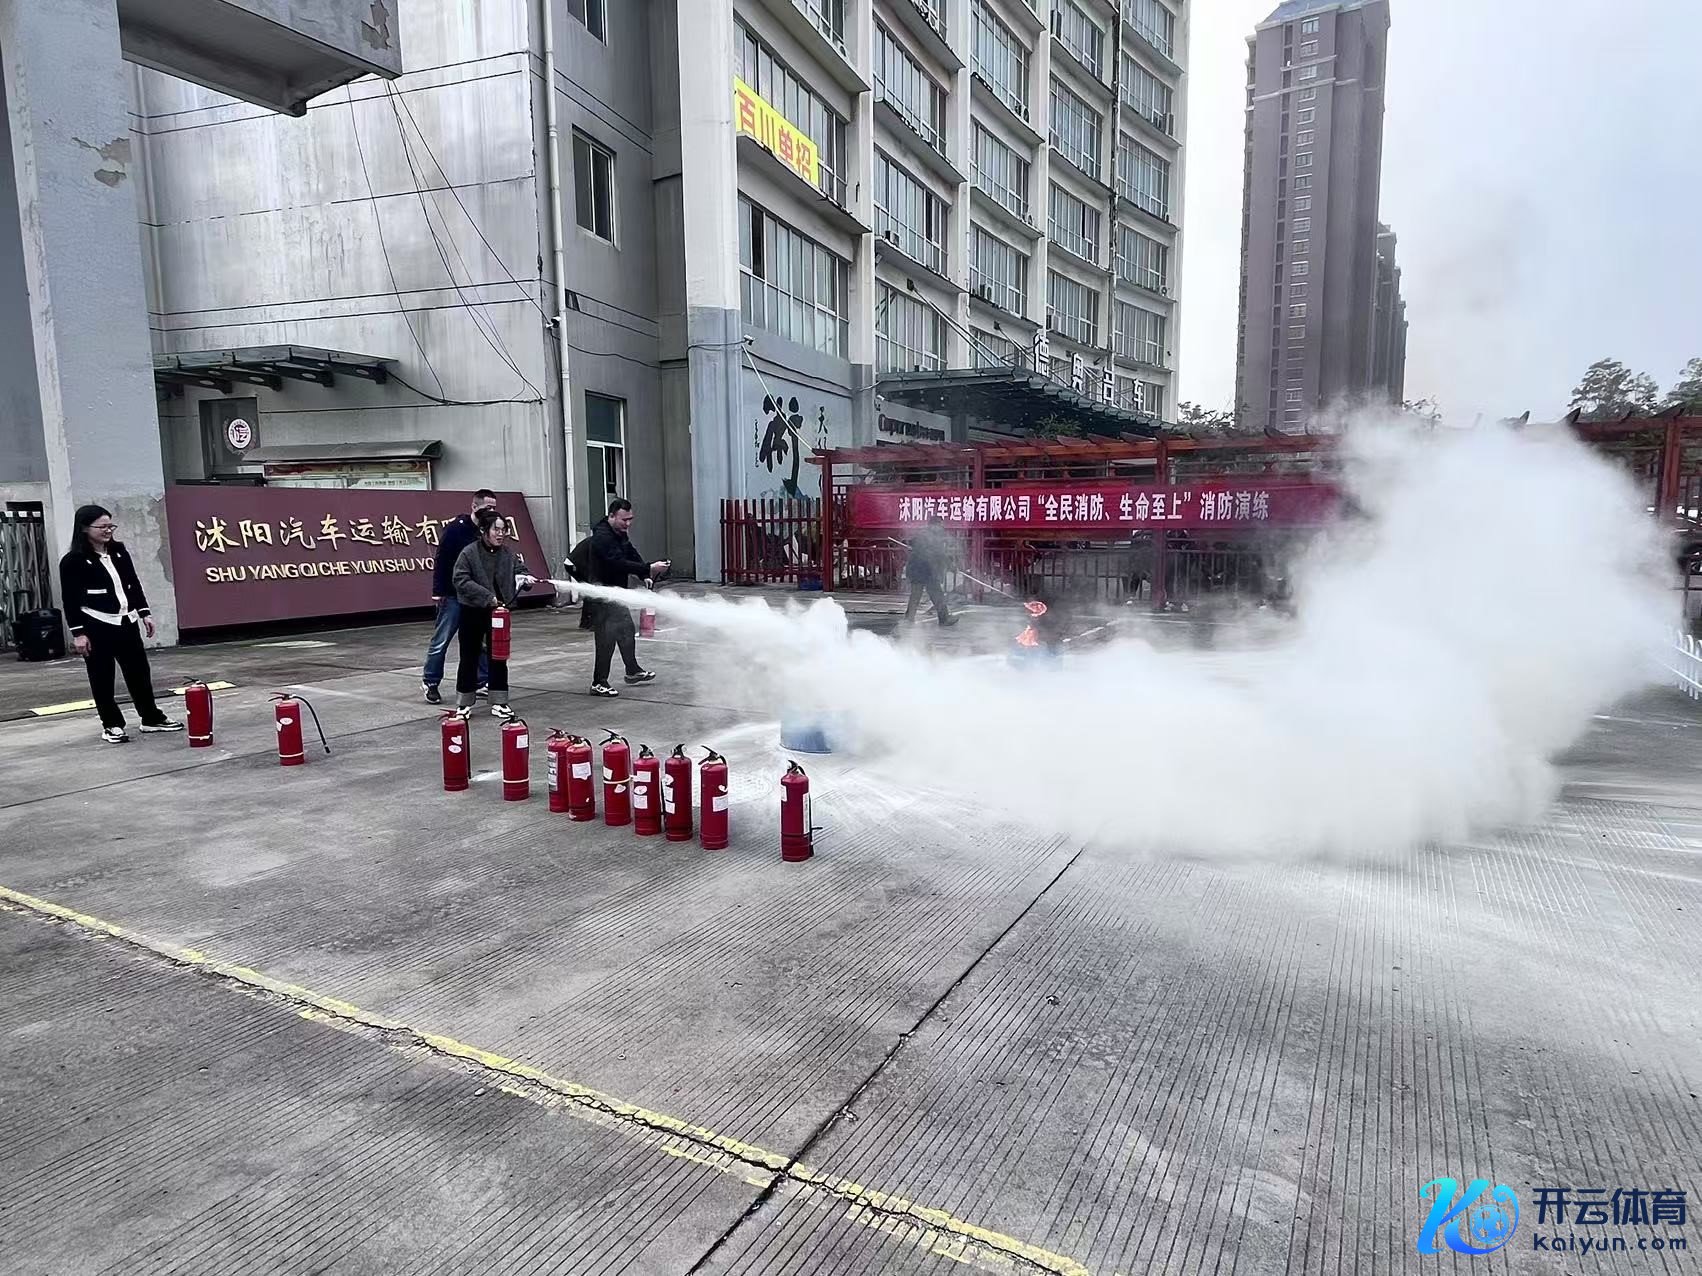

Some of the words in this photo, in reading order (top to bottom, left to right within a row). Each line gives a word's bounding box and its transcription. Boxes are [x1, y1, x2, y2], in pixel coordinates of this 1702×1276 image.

[737, 88, 812, 184] 百川单招
[899, 495, 1031, 522] 沭阳汽车运输有限公司
[1199, 490, 1270, 521] 消防演练
[195, 514, 520, 553] 沭阳汽车运输有司
